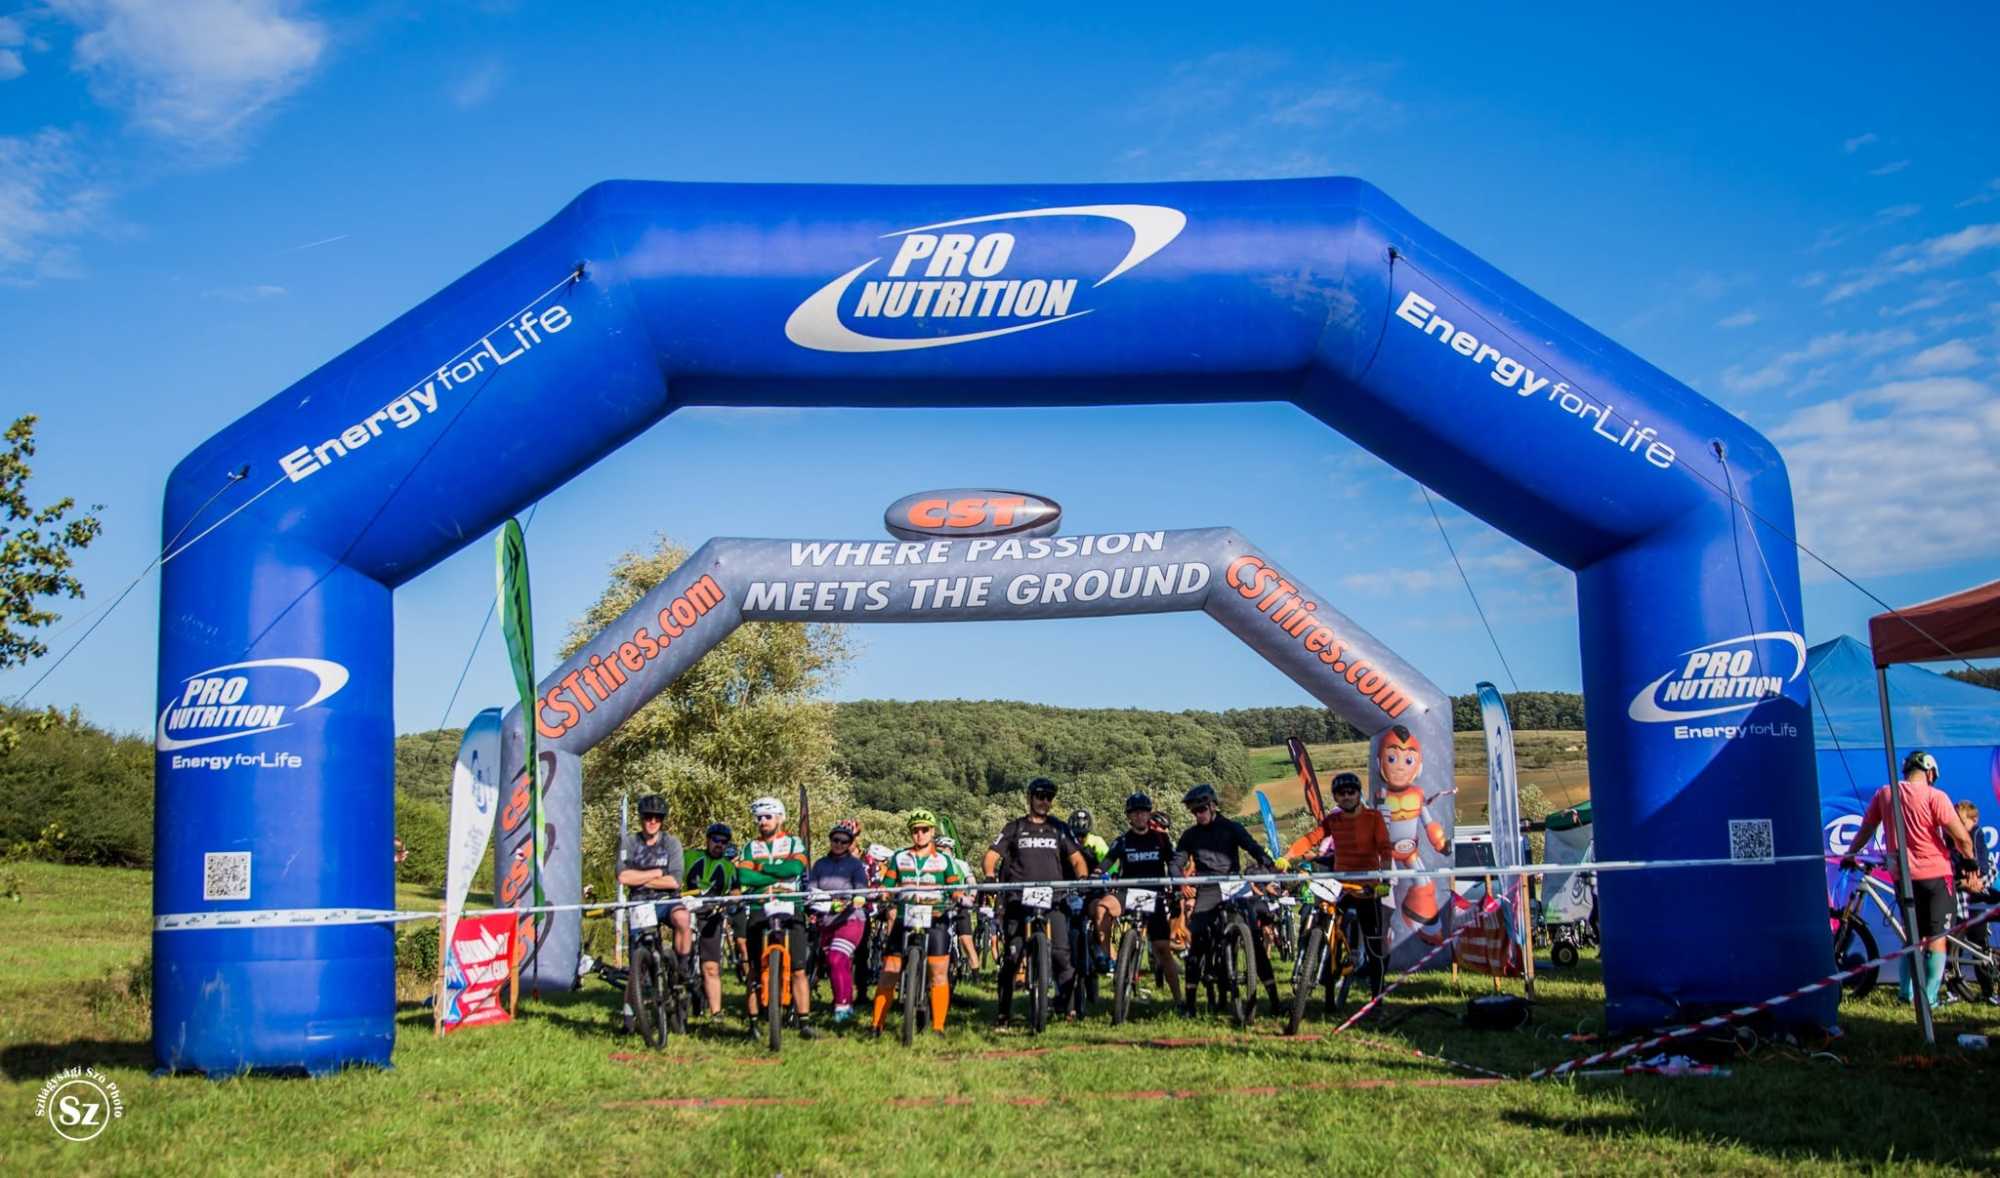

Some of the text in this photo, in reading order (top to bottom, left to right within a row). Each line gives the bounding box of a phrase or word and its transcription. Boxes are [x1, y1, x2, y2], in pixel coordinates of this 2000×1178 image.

[888, 232, 1015, 277] PRO
[853, 278, 1078, 318] NUTRITION
[1395, 291, 1550, 397] Energy
[278, 382, 438, 484] Energy
[906, 498, 1027, 529] CST
[790, 531, 1165, 567] WHERE PASSION
[742, 562, 1211, 611] MEETS THE GROUND
[1226, 555, 1414, 719] CSTtires.com
[536, 574, 726, 739] CSTtires.com
[1682, 650, 1753, 679] PRO
[182, 676, 249, 707] PRO
[1663, 676, 1783, 702] NUTRITION
[168, 705, 286, 731] NUTRITION
[1673, 726, 1747, 740] Energy
[172, 754, 233, 770] Energy
